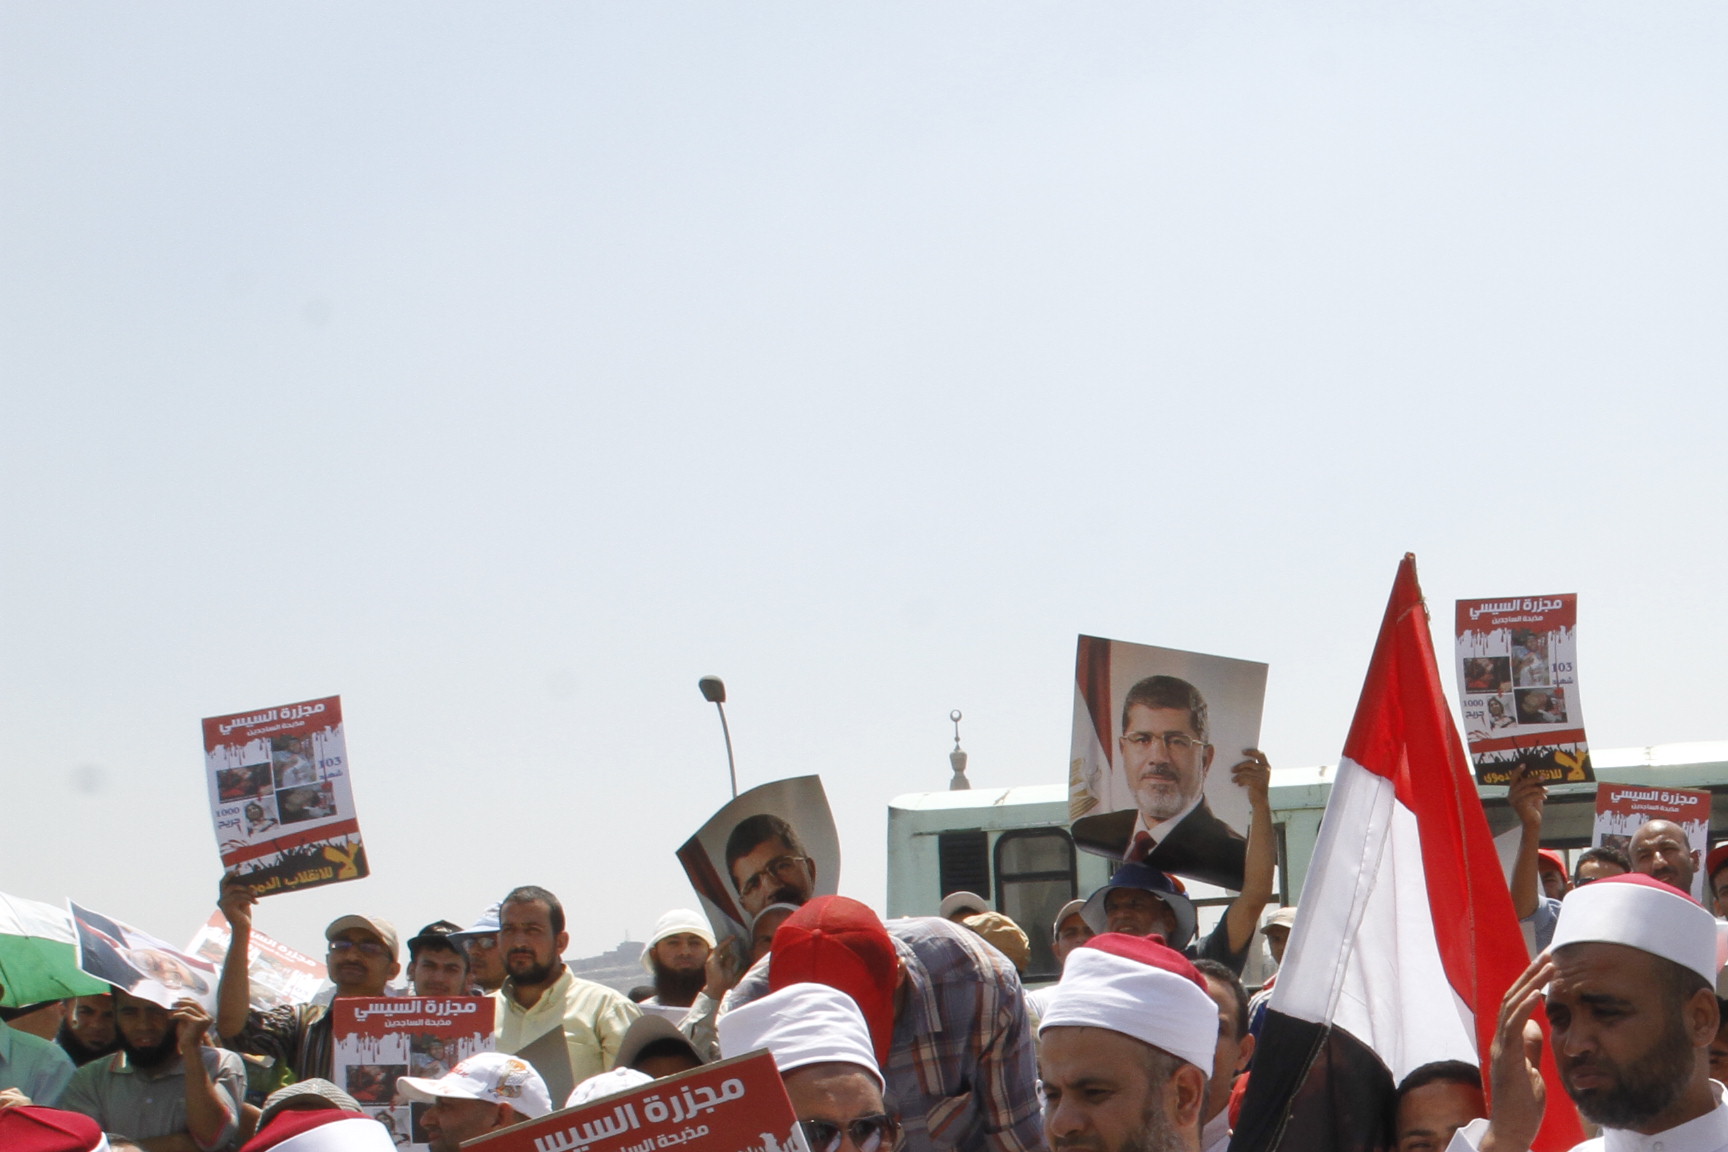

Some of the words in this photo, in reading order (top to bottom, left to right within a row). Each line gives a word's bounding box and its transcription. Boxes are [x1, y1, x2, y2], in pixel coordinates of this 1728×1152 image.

[1469, 599, 1521, 620] السيسي
[1523, 598, 1563, 612] مجزرة
[1491, 616, 1522, 625] الساجدين
[1523, 615, 1544, 623] مذبحة
[1551, 662, 1573, 673] 103
[280, 703, 325, 719] مجزرة
[219, 710, 277, 735] السيسي
[318, 756, 341, 769] 103
[1554, 748, 1590, 781] لا
[1610, 790, 1658, 803] السيسي
[1661, 791, 1698, 806] مجزرة
[216, 807, 240, 818] 1000
[323, 841, 361, 880] لا
[283, 866, 333, 889] للانقلاب
[354, 1000, 422, 1022] السيسي
[425, 999, 476, 1016] مجزرة
[384, 1019, 424, 1028] الساجدين
[424, 1018, 452, 1027] مذبحة
[643, 1077, 746, 1124] مجزرة
[657, 1125, 710, 1149] مذبحة
